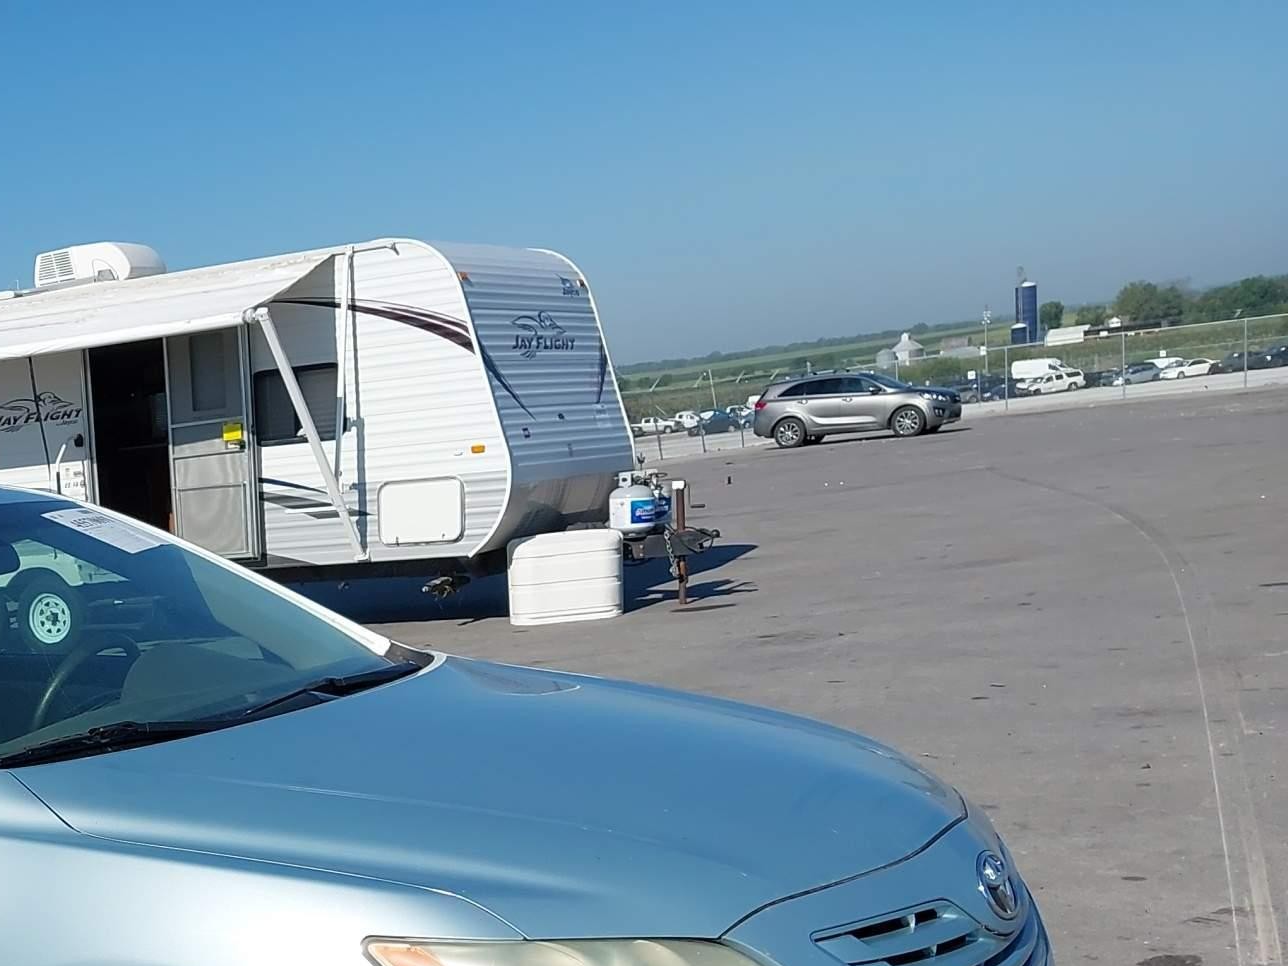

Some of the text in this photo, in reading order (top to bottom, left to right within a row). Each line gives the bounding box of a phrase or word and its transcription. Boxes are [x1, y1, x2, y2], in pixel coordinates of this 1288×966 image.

[512, 335, 575, 350] JAY FLIGHT
[24, 408, 83, 424] FLIGHT
